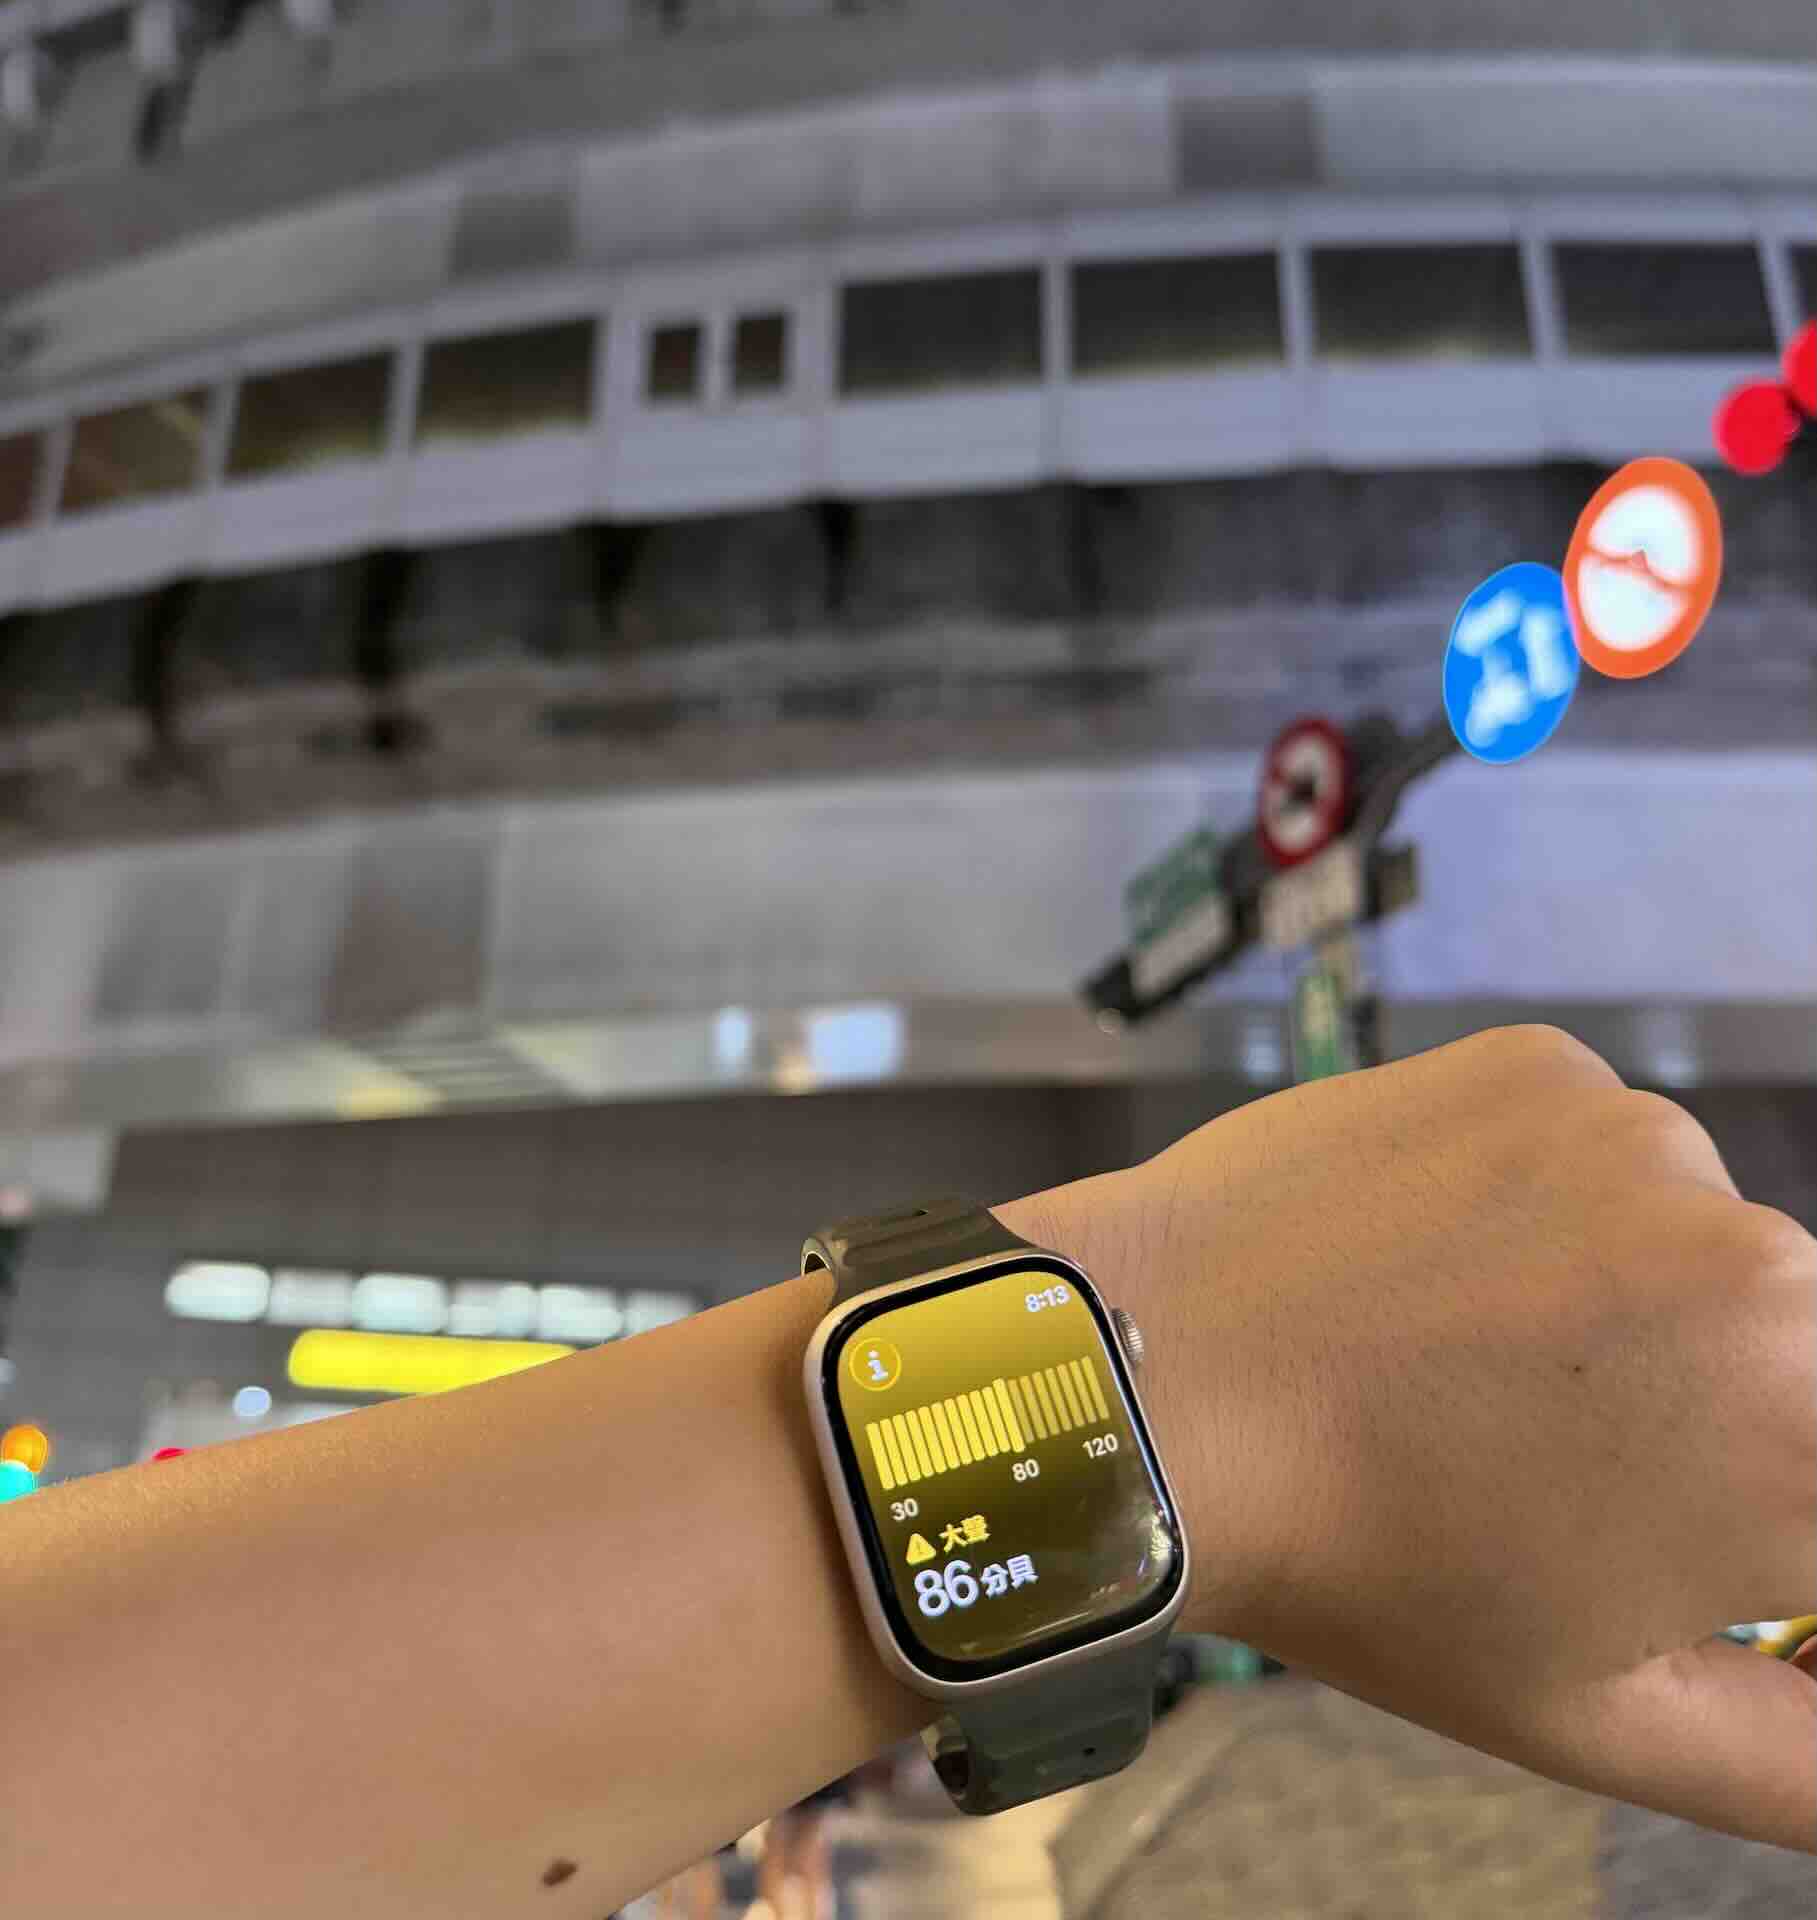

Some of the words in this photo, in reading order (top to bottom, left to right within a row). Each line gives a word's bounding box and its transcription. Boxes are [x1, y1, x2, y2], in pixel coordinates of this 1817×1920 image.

[1025, 1284, 1071, 1313] 8:13
[1083, 1433, 1119, 1459] 120
[1012, 1459, 1040, 1482] 80
[890, 1498, 919, 1522] 30
[939, 1514, 990, 1553] 大聲
[914, 1559, 979, 1617] 86
[980, 1554, 1039, 1597] 分貝
